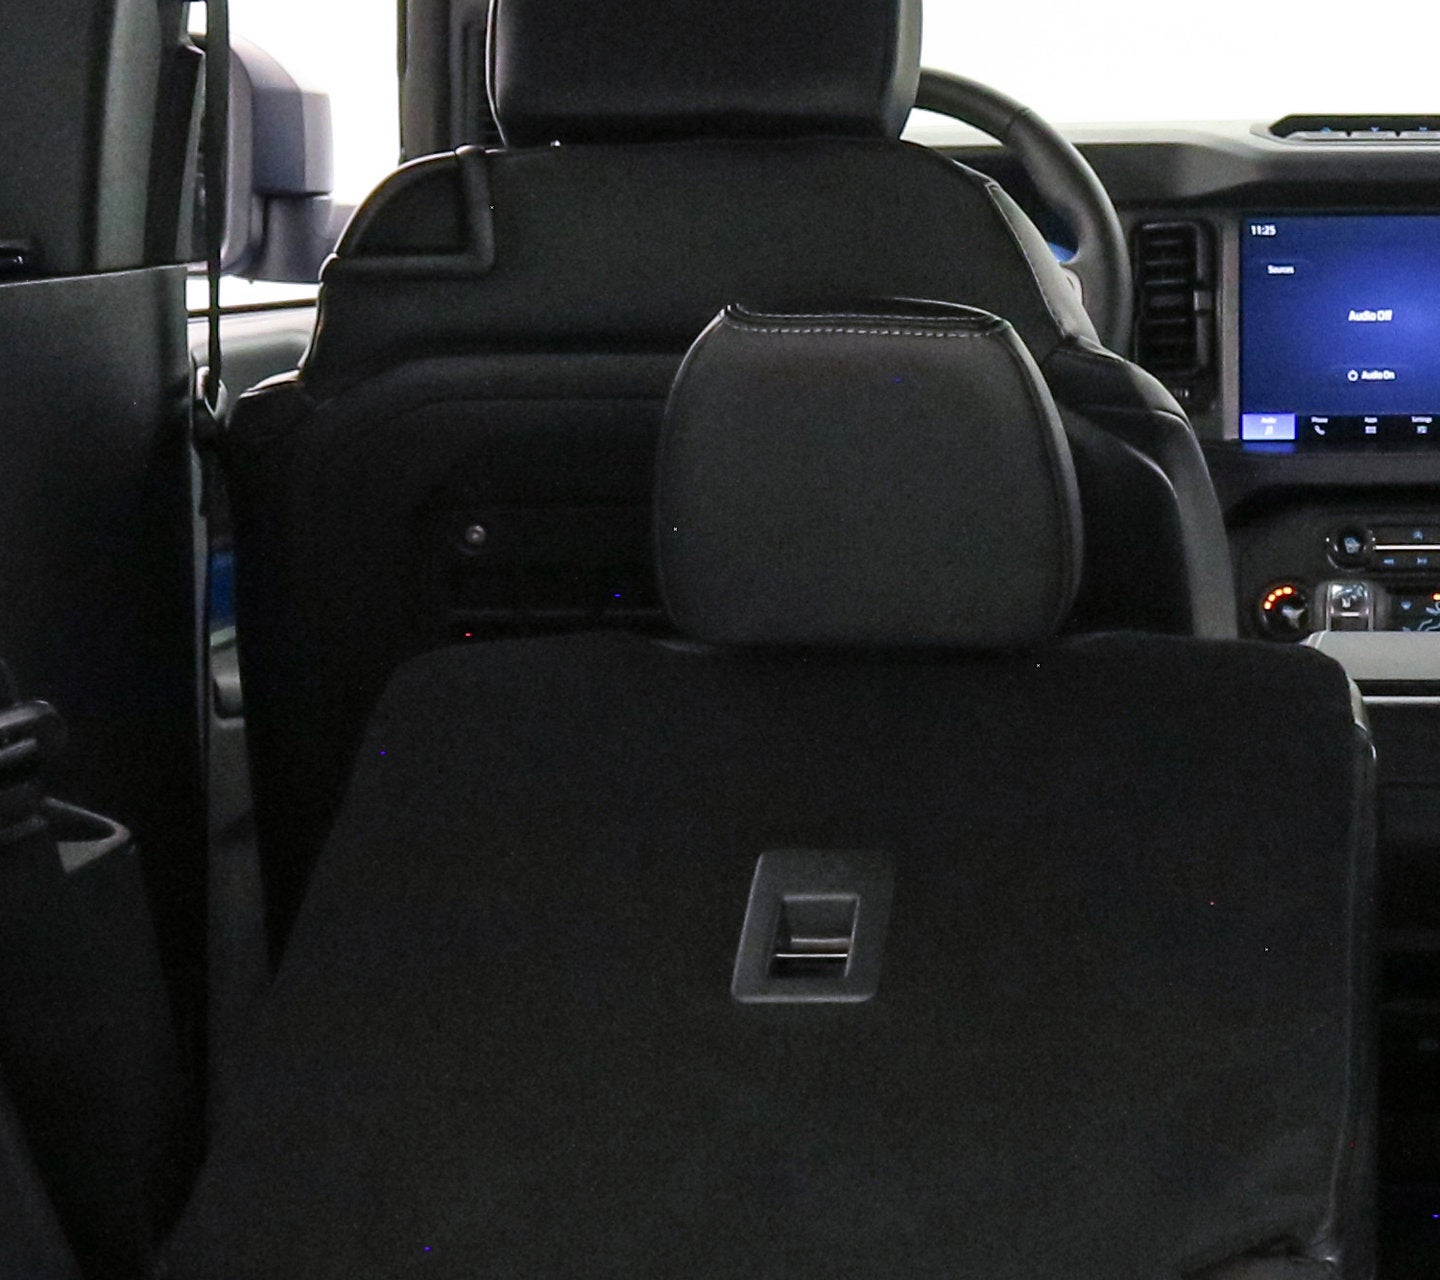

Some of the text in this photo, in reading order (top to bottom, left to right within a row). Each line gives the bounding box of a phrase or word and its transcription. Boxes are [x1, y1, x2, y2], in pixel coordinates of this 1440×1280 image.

[1250, 224, 1277, 236] 11:25
[1267, 264, 1295, 274] Sources
[1348, 309, 1393, 321] Audio Off
[1361, 370, 1396, 380] Audio On
